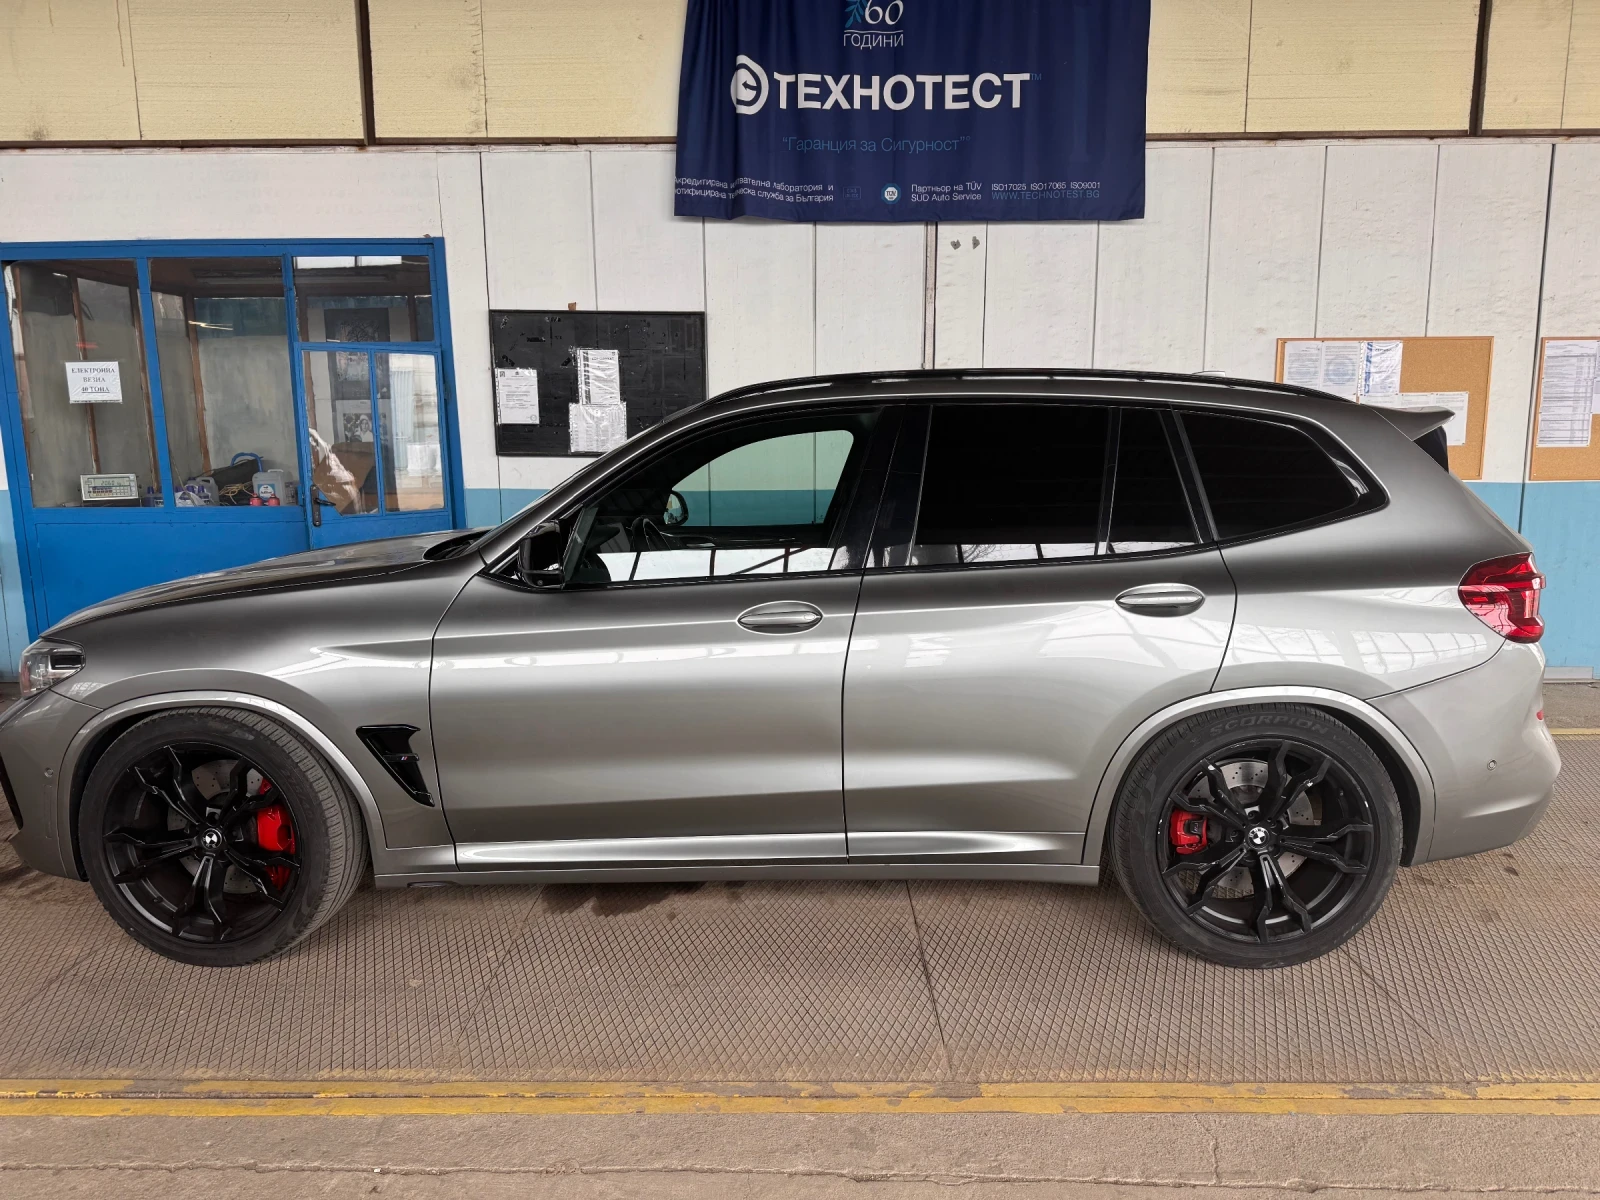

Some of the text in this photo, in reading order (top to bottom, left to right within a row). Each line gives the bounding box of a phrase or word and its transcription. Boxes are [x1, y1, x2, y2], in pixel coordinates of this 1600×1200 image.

[843, 32, 904, 50] ГОДИНИ
[773, 72, 1031, 111] ТЕХНОТЕСТ
[860, 139, 877, 152] за
[773, 180, 823, 193] лаборатория
[911, 183, 951, 194] Партньор
[966, 180, 983, 191] TÜV
[991, 182, 1027, 191] ISO17025
[1070, 181, 1101, 190] ISO9001
[757, 189, 784, 201] служба
[785, 194, 794, 202] за
[795, 193, 834, 203] България
[911, 192, 982, 202] SÜD Auto Service
[991, 189, 1100, 200] WWW.TECHNOTEST.BG
[1210, 715, 1330, 737] SCORPION
